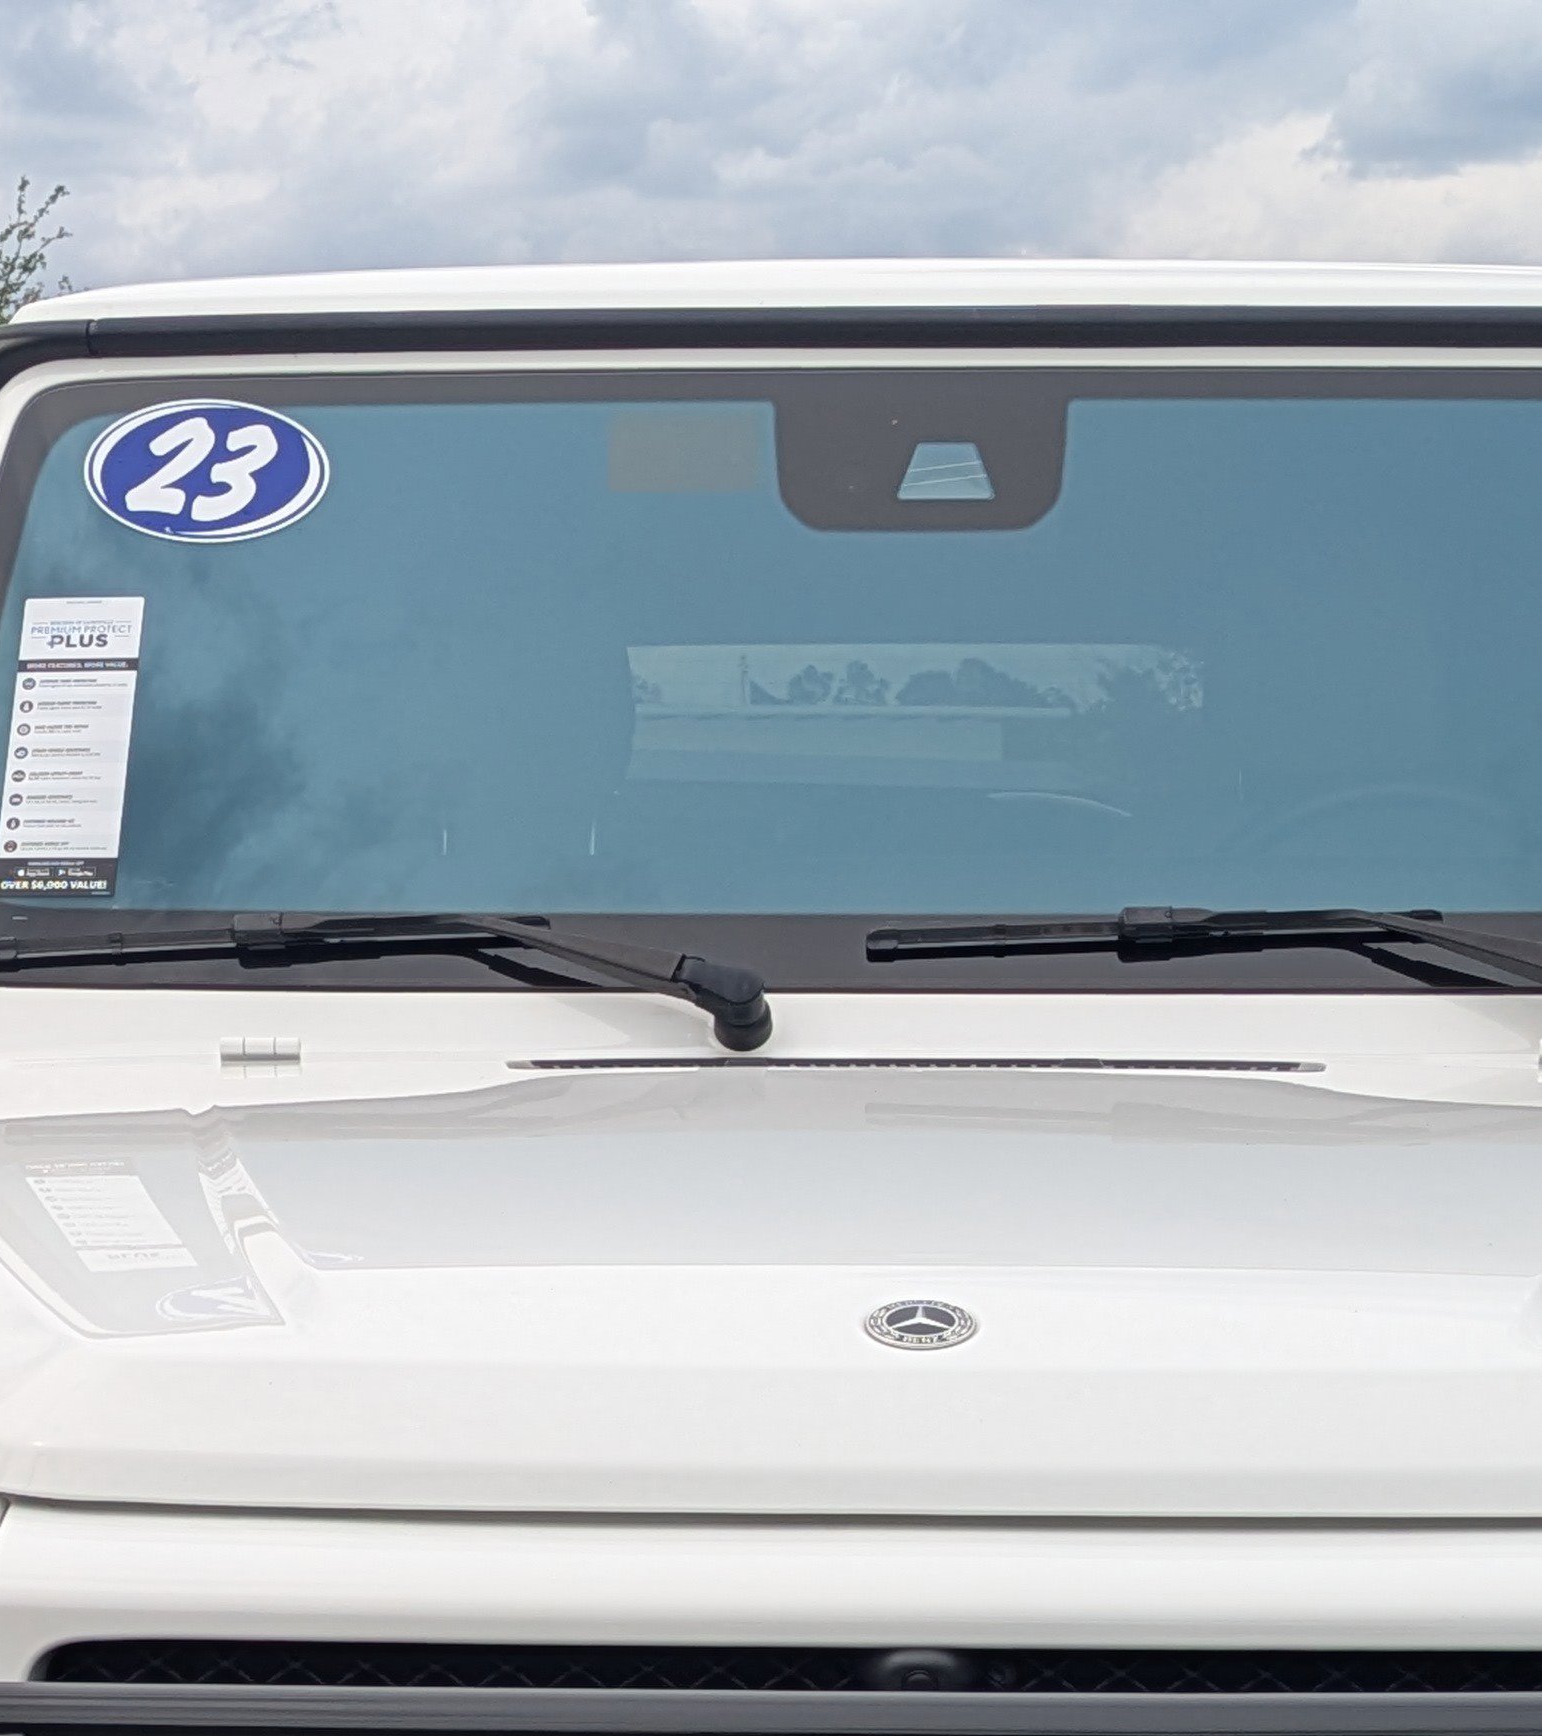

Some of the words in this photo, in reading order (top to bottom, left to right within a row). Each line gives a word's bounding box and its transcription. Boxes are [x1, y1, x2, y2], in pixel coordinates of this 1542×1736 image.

[124, 416, 279, 522] 23
[31, 625, 82, 635] PREMIUM
[84, 624, 133, 634] PROTECT
[47, 633, 109, 649] PLUS
[0, 880, 30, 889] OVER
[70, 879, 108, 889] VALUE!
